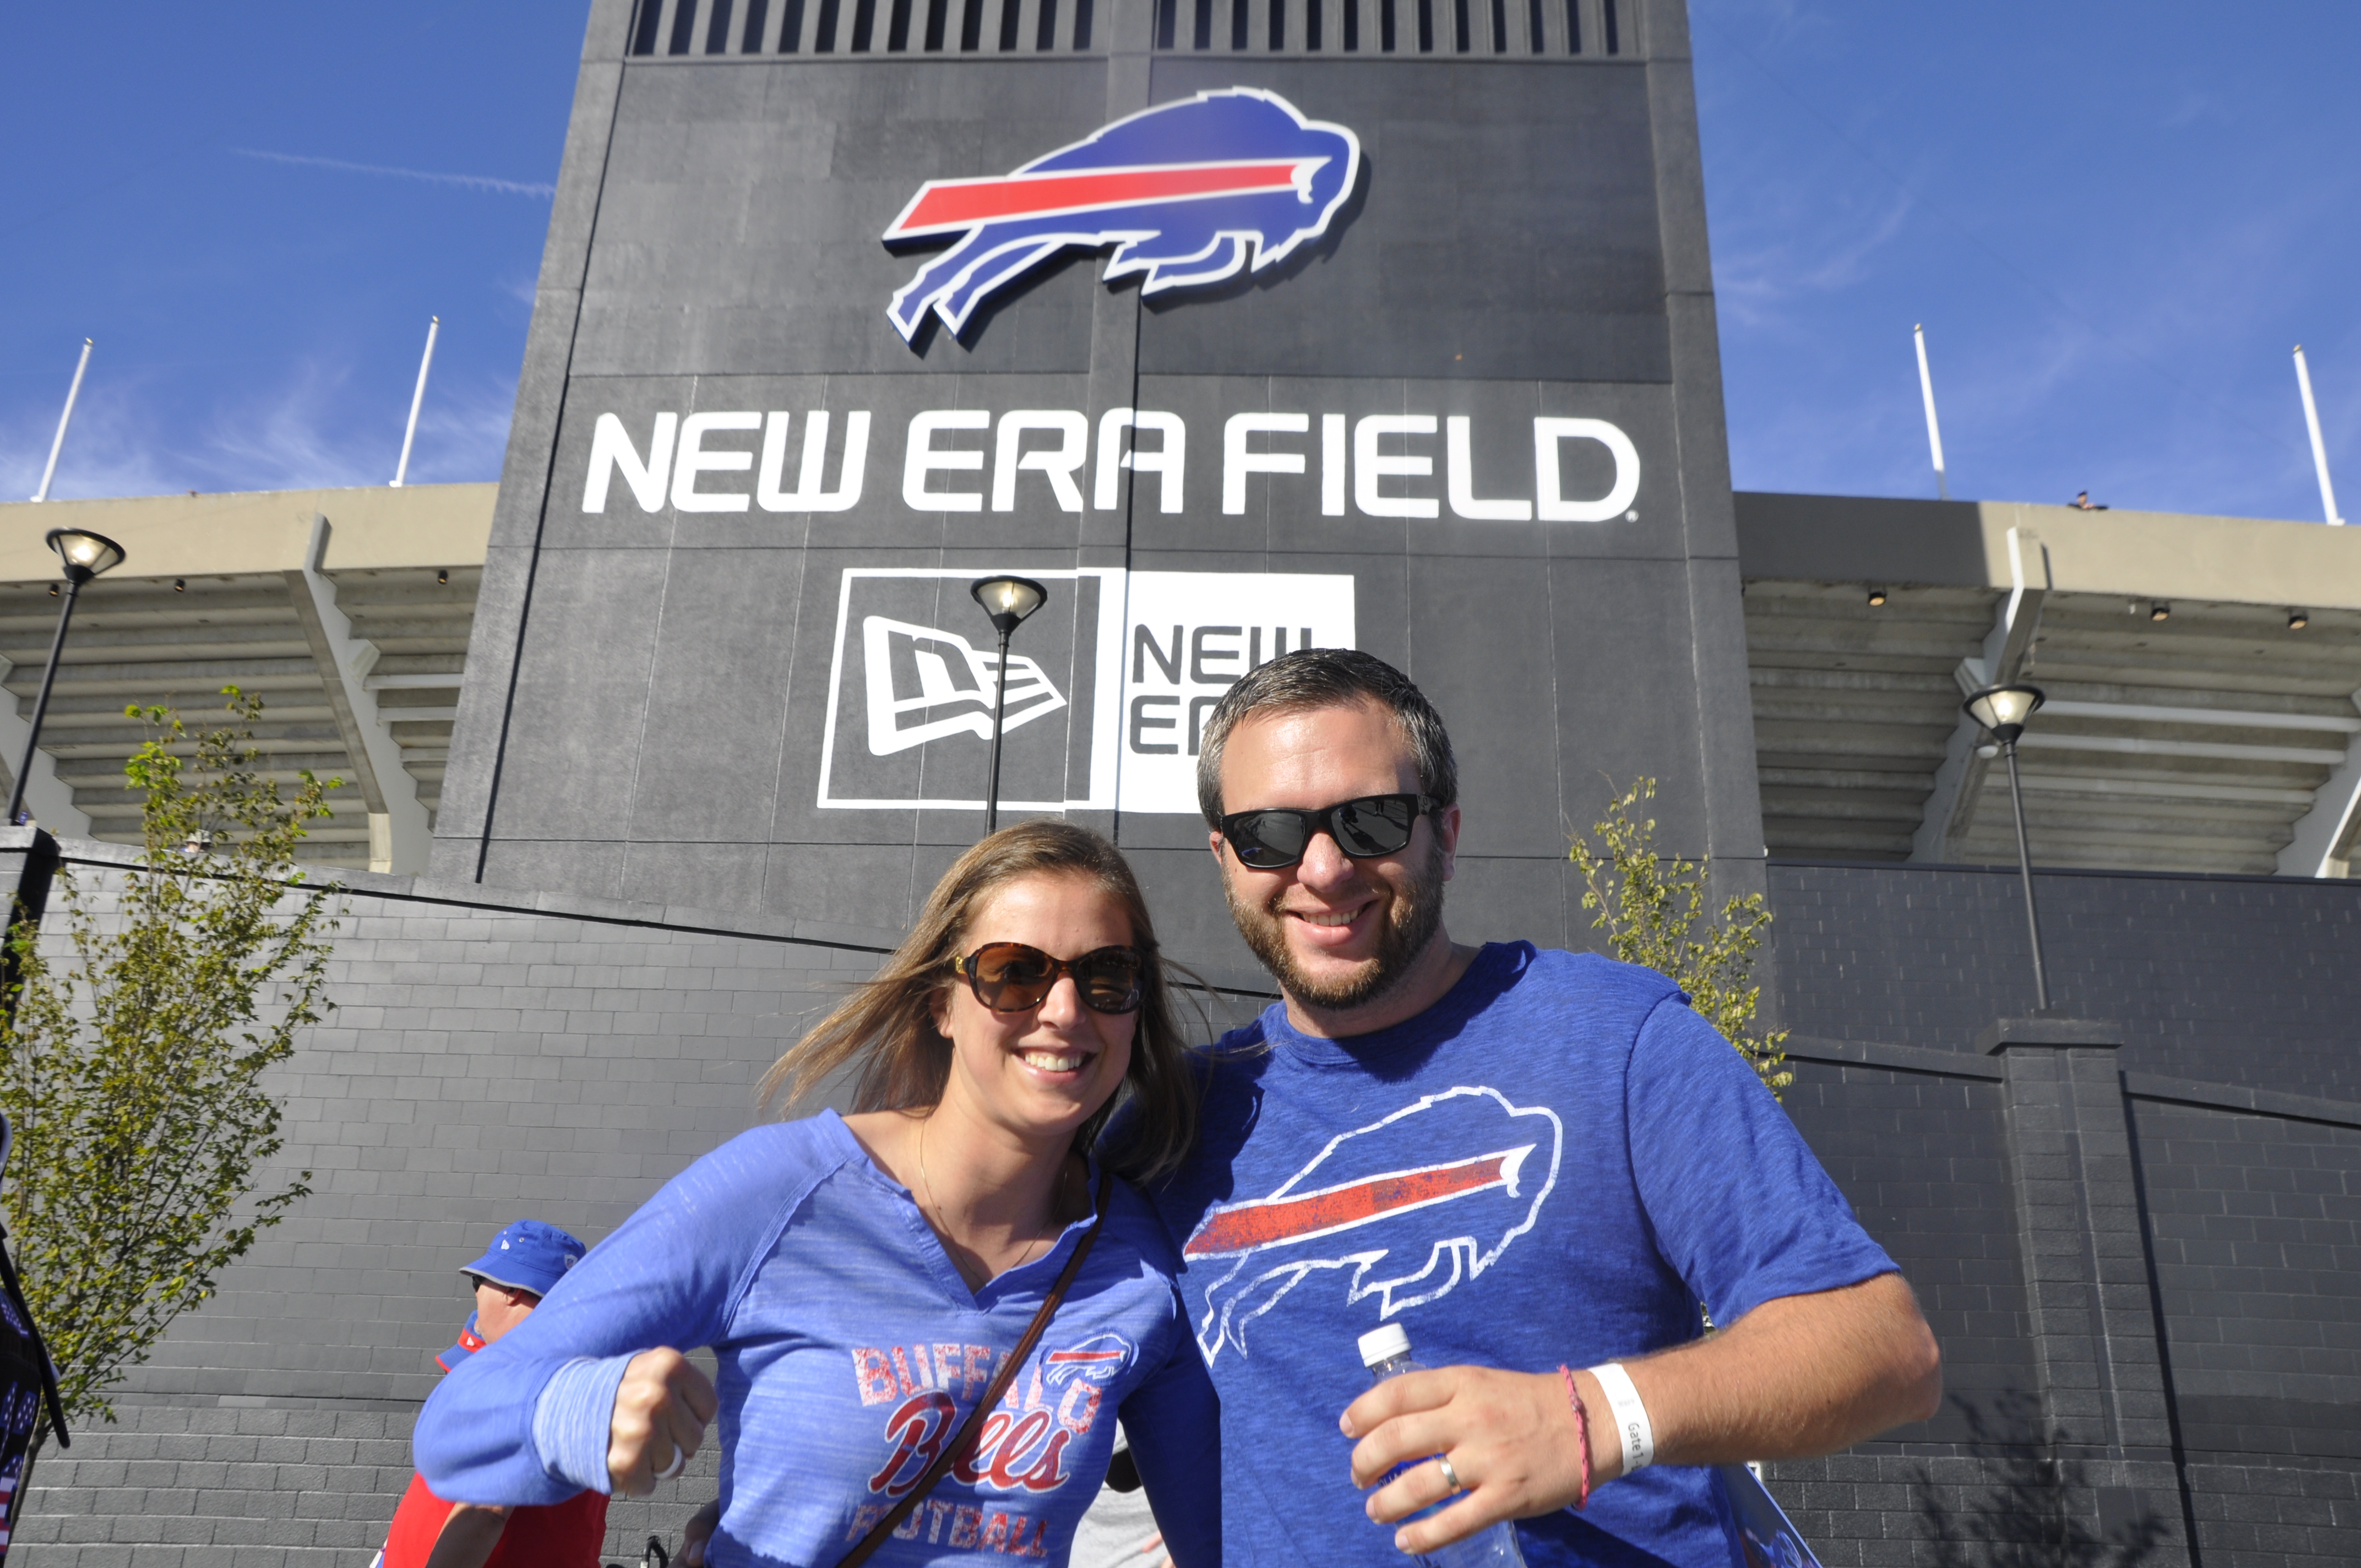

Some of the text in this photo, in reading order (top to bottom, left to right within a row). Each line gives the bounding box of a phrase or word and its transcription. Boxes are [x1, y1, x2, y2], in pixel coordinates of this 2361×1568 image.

[582, 410, 871, 513] NEW
[902, 407, 1186, 513] ERA
[868, 1389, 1070, 1498] Blls
